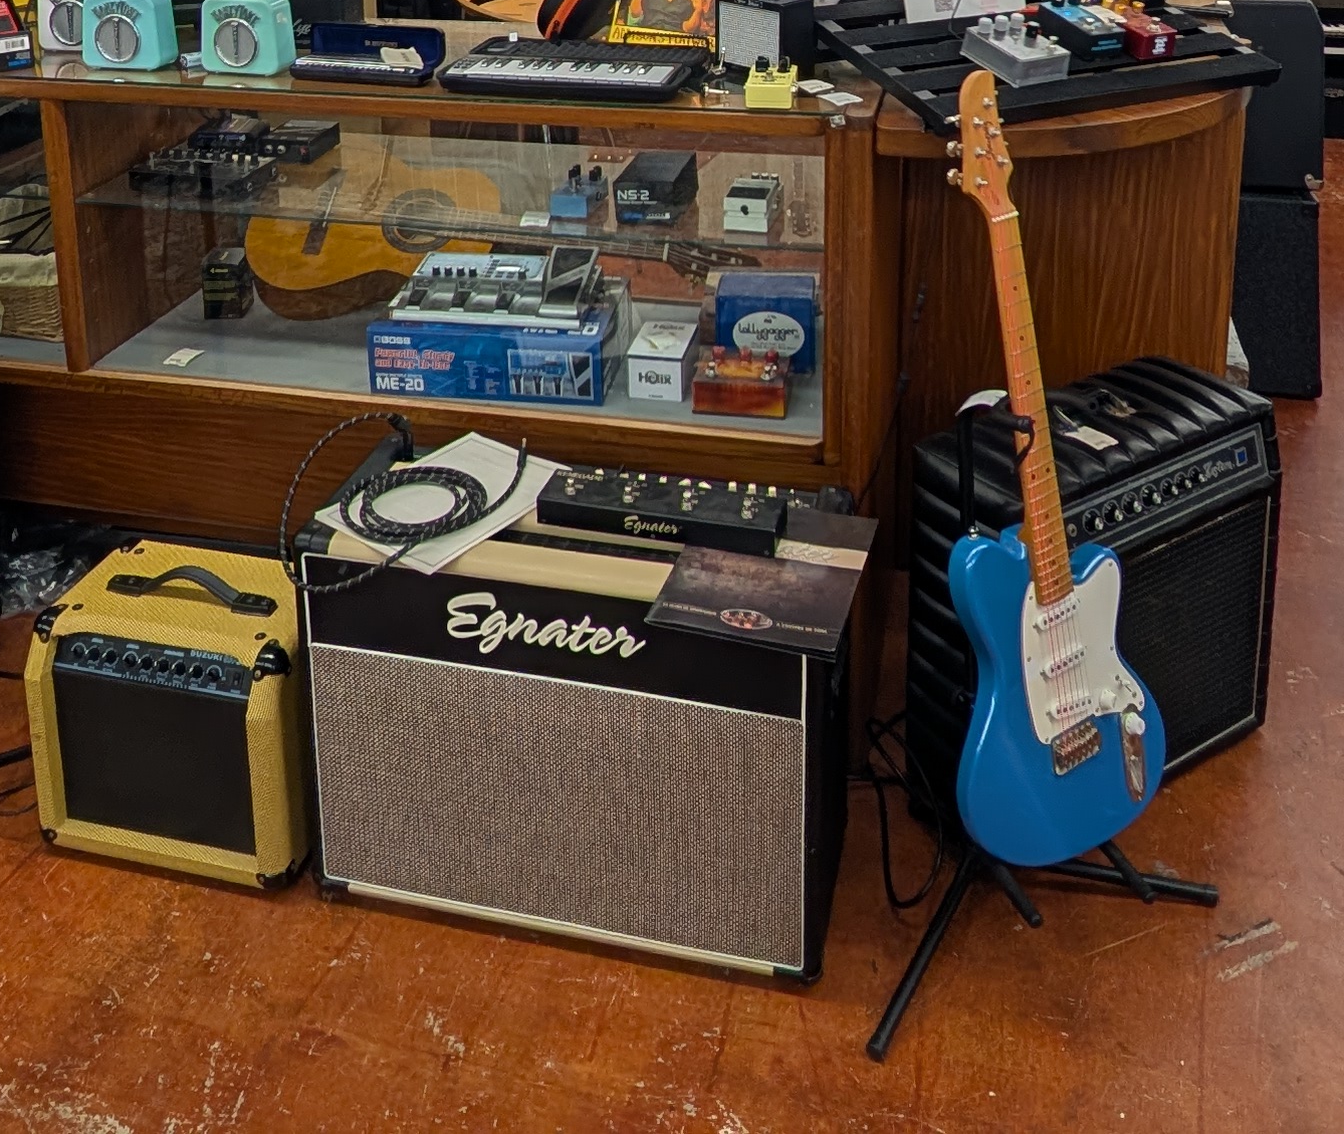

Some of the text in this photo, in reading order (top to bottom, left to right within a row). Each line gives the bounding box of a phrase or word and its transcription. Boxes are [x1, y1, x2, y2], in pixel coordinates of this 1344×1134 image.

[617, 189, 650, 201] NS-2
[381, 335, 411, 345] BOSS
[376, 376, 425, 391] ME-20
[624, 514, 678, 535] Egnater
[446, 591, 646, 659] Egnater
